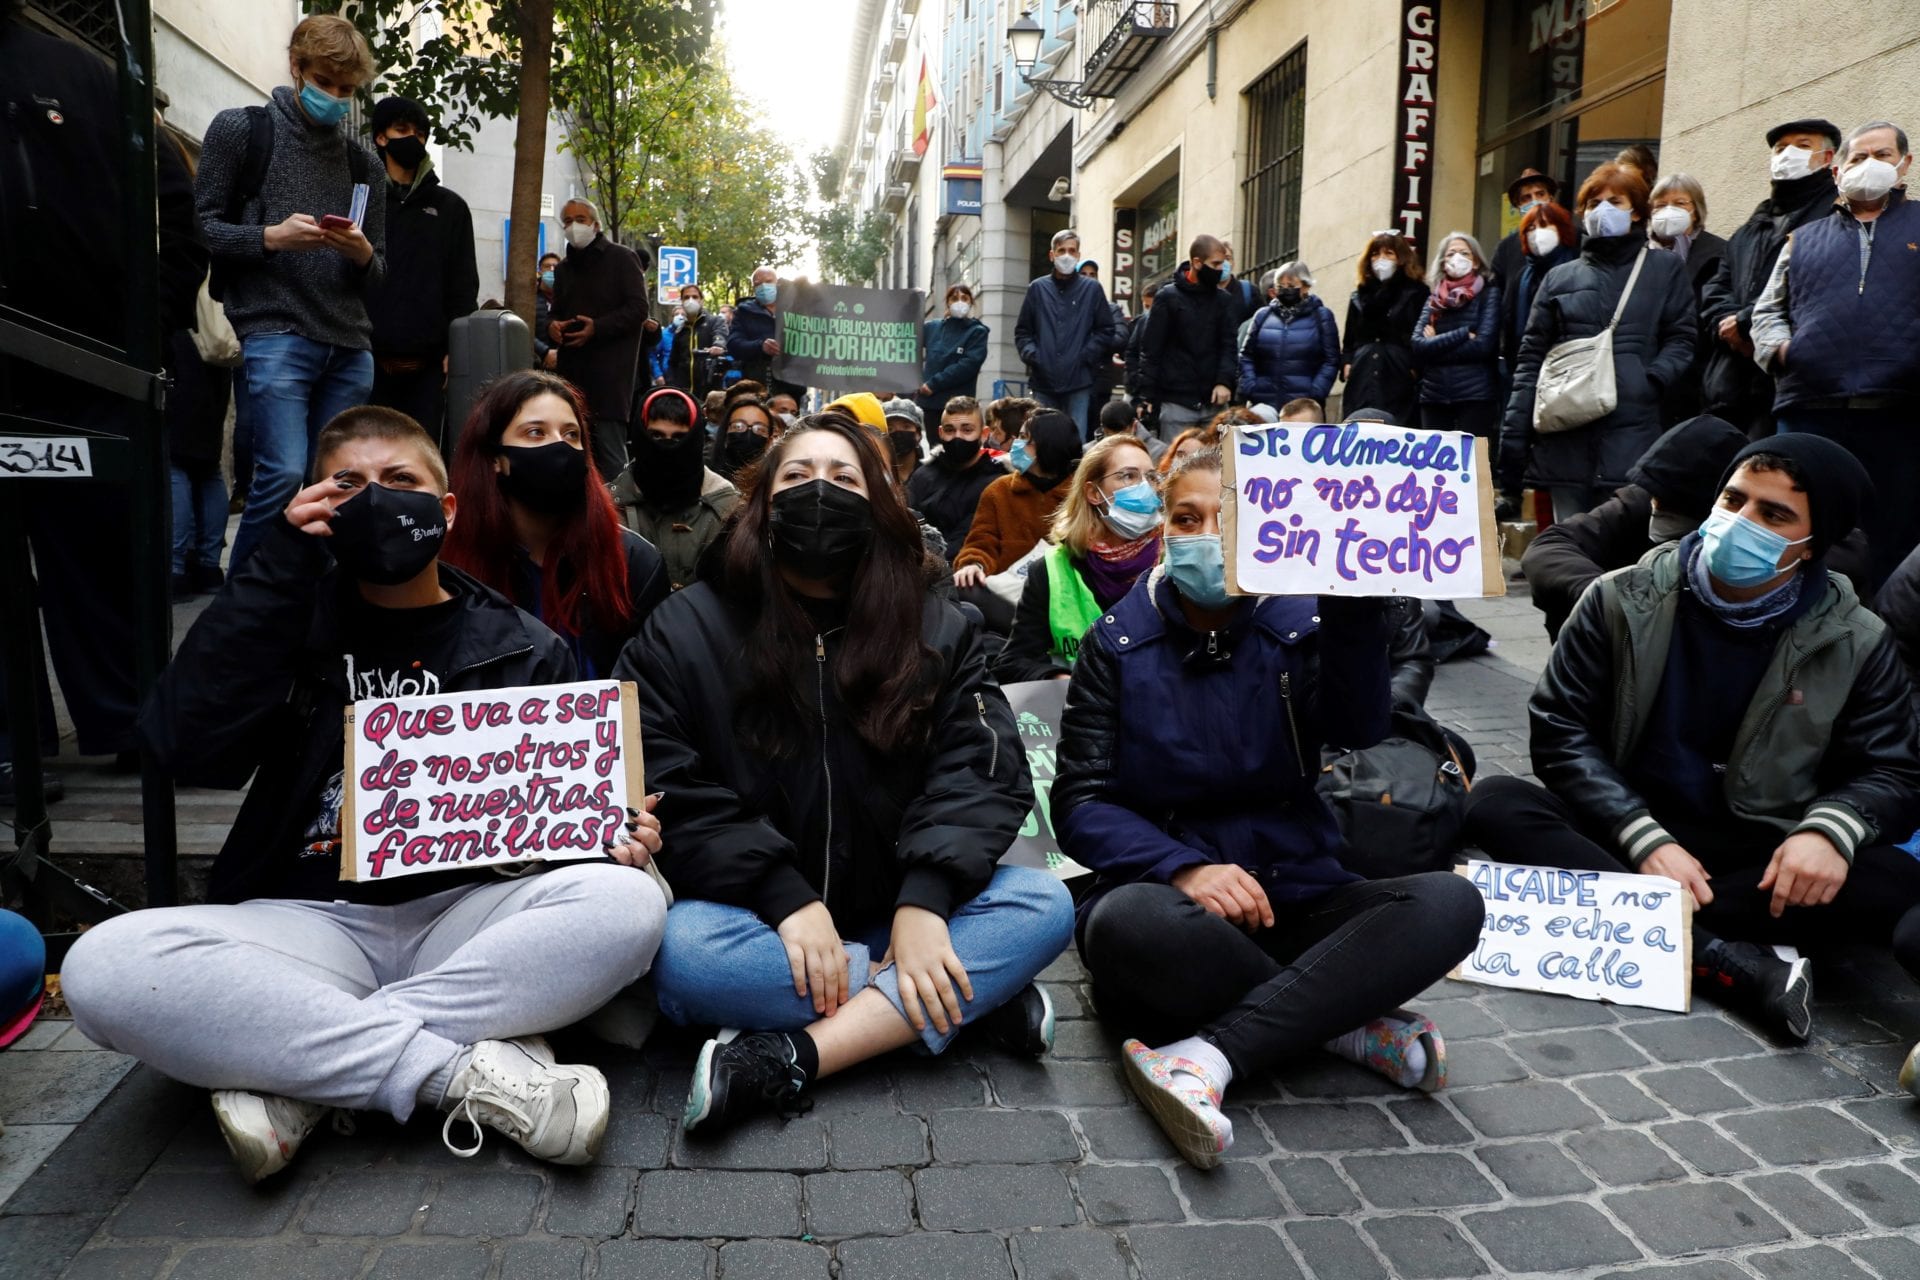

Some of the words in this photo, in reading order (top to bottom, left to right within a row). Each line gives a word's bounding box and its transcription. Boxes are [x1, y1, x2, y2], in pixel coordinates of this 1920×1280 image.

[1400, 6, 1436, 252] GRAFFIT
[783, 311, 828, 334] VIVIENDA
[829, 316, 871, 336] PÚBLICA
[870, 321, 880, 336] Y
[881, 322, 917, 338] SOCIAL
[784, 328, 822, 358] TODO
[824, 335, 858, 360] POR
[861, 338, 916, 363] HACER
[1240, 428, 1291, 457] Sr.
[397, 515, 415, 527] The
[1243, 477, 1302, 514] no
[1313, 475, 1381, 512] nos
[1385, 472, 1458, 531] deje
[1335, 518, 1474, 582] techo
[1063, 636, 1080, 657] AP
[364, 702, 455, 750] Que
[462, 701, 512, 731] va
[518, 698, 549, 724] a
[556, 686, 619, 723] ser
[1016, 724, 1053, 737] PAH
[360, 749, 417, 791] de
[423, 733, 589, 785] nosotros
[595, 720, 619, 777] y
[363, 789, 419, 835] de
[428, 773, 613, 823] nuestras
[367, 805, 624, 877] familias?
[1471, 864, 1600, 906] ALCALDE
[1612, 890, 1671, 910] no
[1545, 909, 1633, 944] eche
[1643, 926, 1676, 952] a
[1472, 938, 1519, 977] la
[1538, 946, 1642, 988] calle
